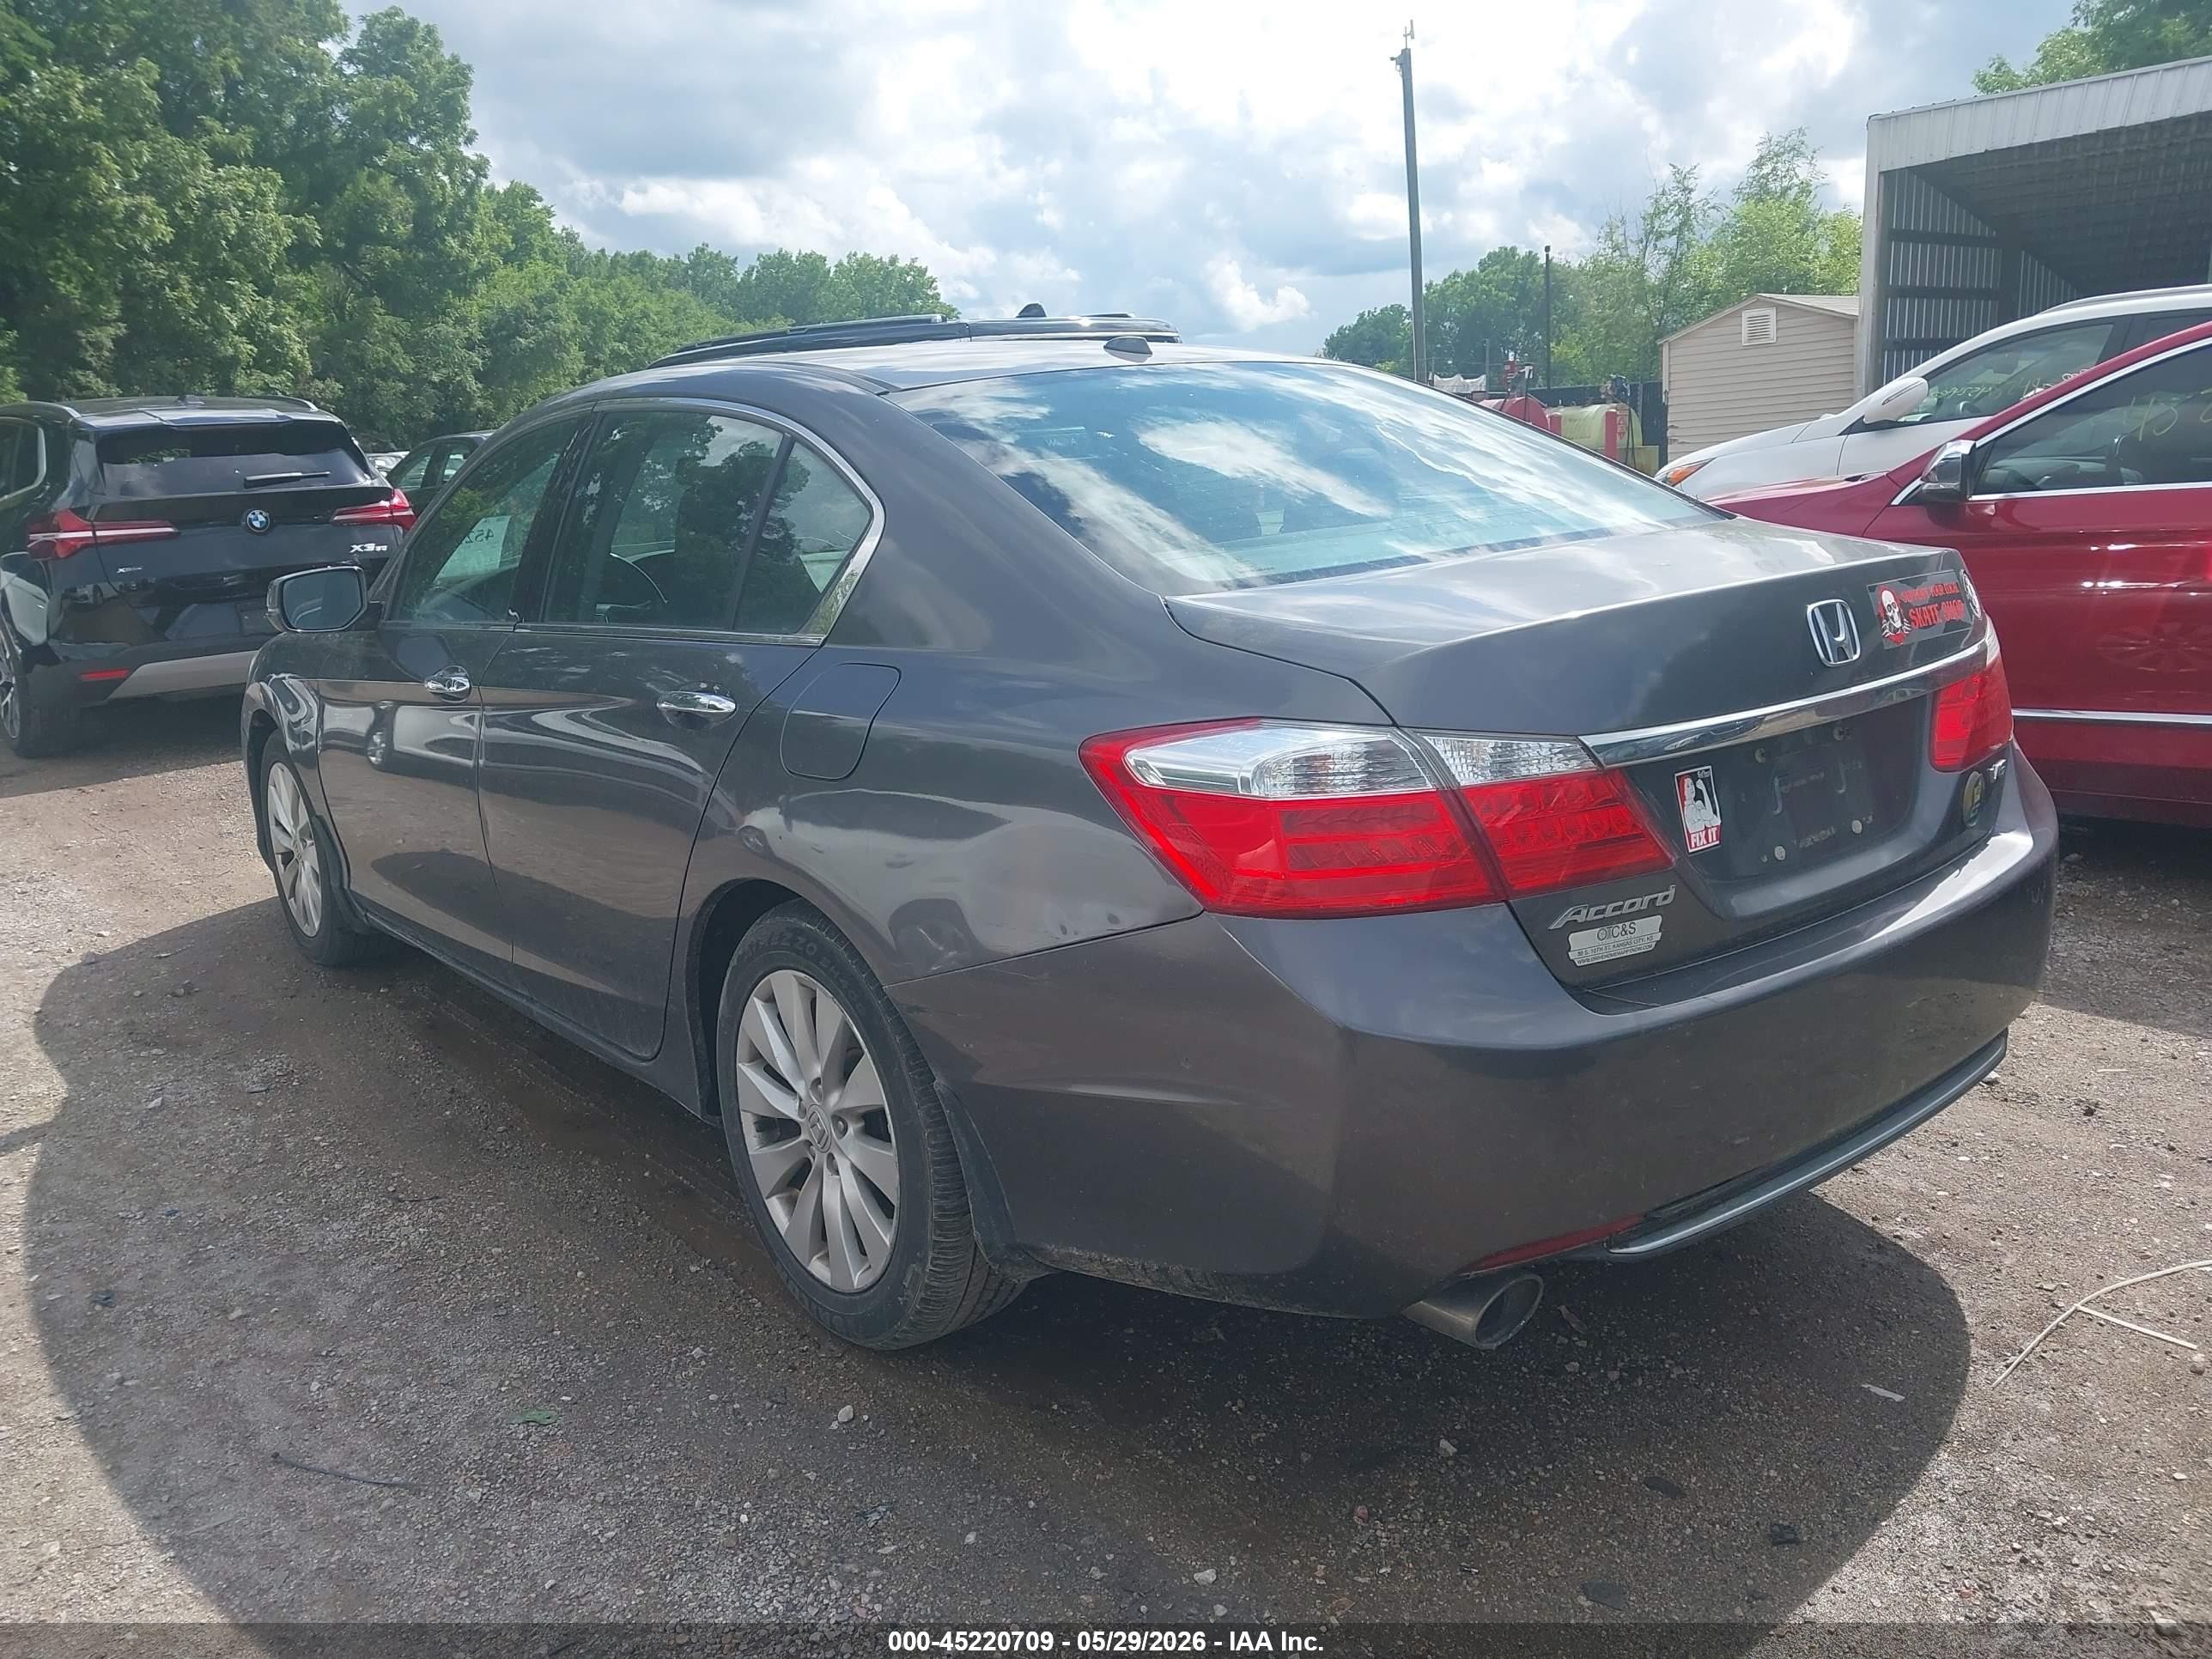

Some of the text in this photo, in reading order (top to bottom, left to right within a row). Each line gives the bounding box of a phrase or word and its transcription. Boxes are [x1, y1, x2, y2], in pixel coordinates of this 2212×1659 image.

[1909, 599, 1966, 629] SKATE SHOP
[1690, 826, 1719, 849] FIX IT
[1547, 884, 1677, 930] Accord
[1612, 939, 1633, 949] KANSAS
